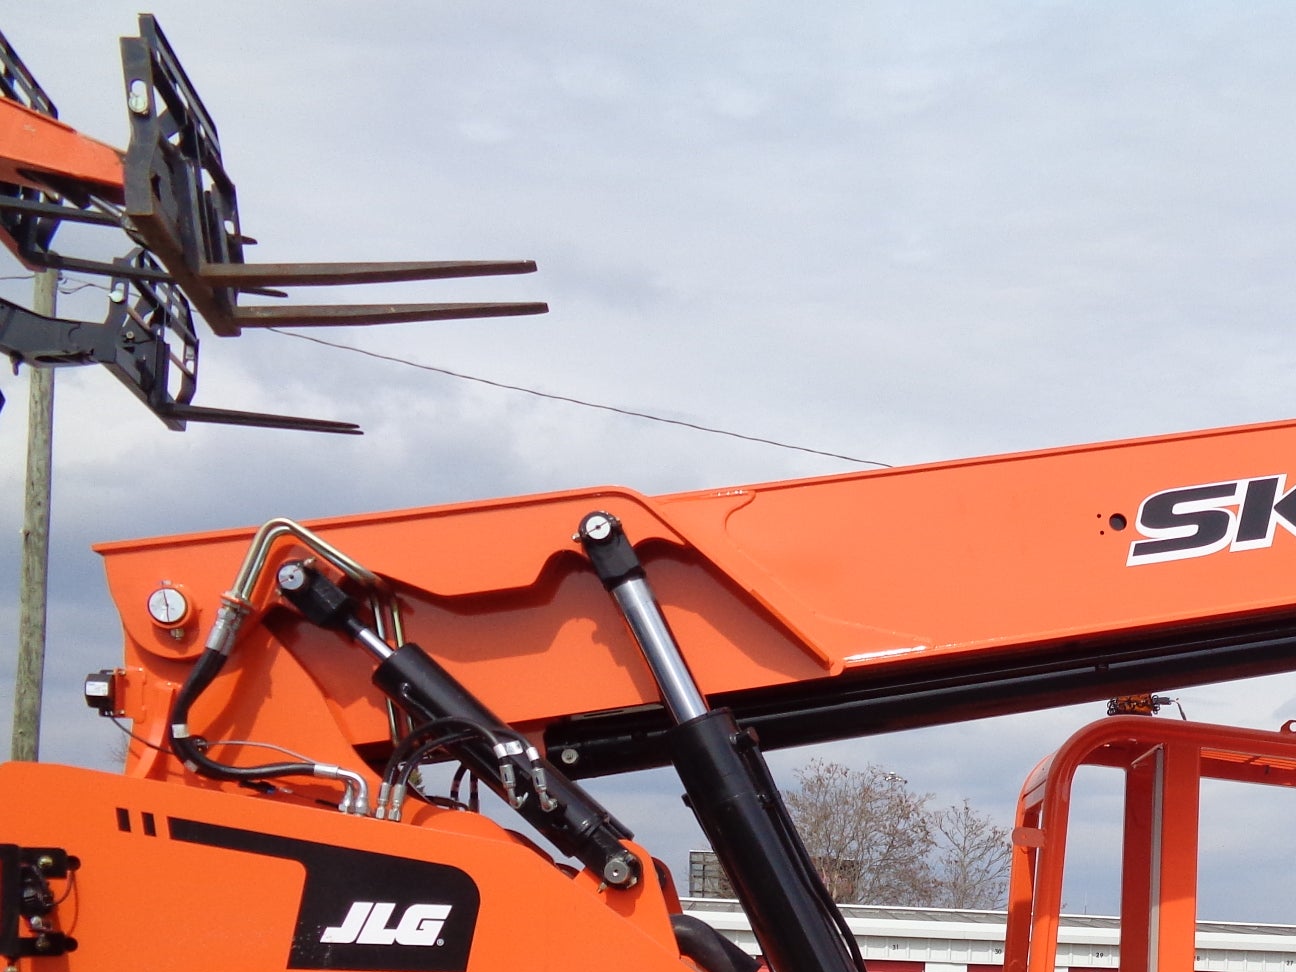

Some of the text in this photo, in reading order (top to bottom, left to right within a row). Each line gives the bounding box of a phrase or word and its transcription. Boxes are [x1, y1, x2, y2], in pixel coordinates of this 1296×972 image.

[320, 901, 453, 946] JLG
[891, 943, 899, 951] 31
[1095, 951, 1104, 959] 29
[1286, 959, 1294, 967] 27
